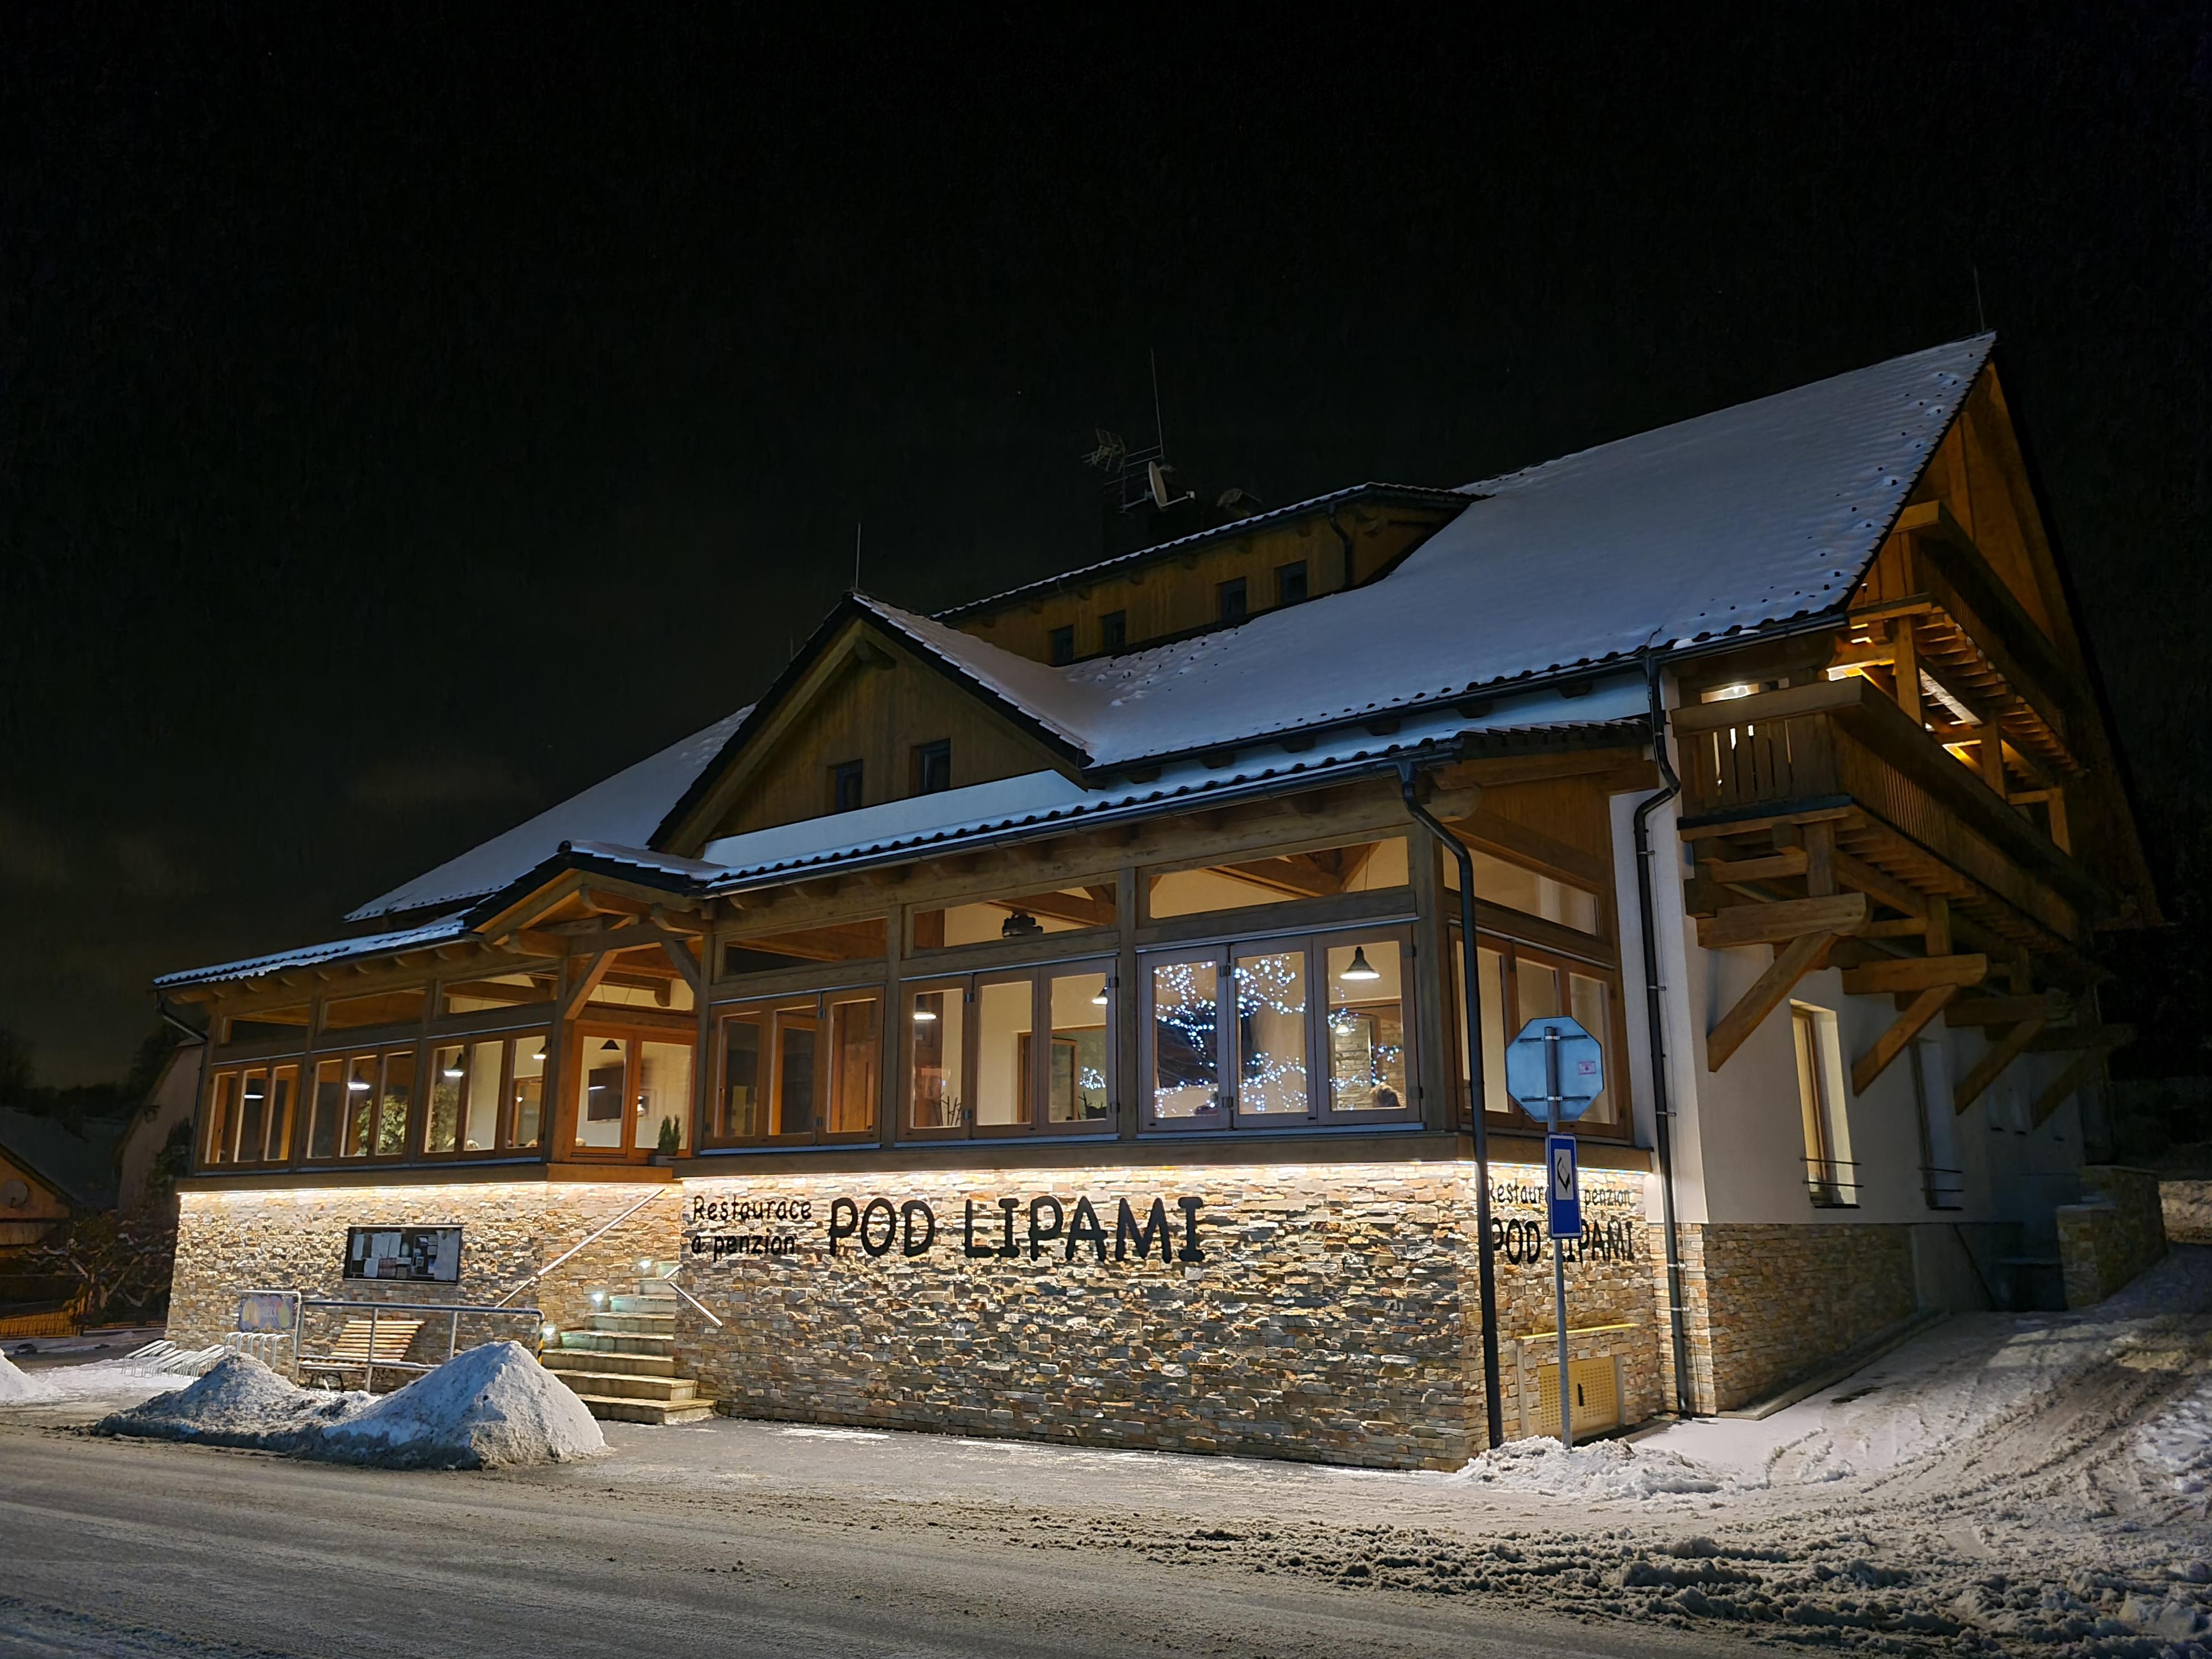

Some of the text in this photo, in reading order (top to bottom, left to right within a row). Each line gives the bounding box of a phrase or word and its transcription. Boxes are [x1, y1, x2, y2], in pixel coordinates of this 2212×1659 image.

[692, 1194, 812, 1220] Restaurace
[1489, 1176, 1631, 1215] Restaur penzion
[691, 1227, 795, 1262] a penzion
[829, 1195, 1205, 1264] POD LIPAMI
